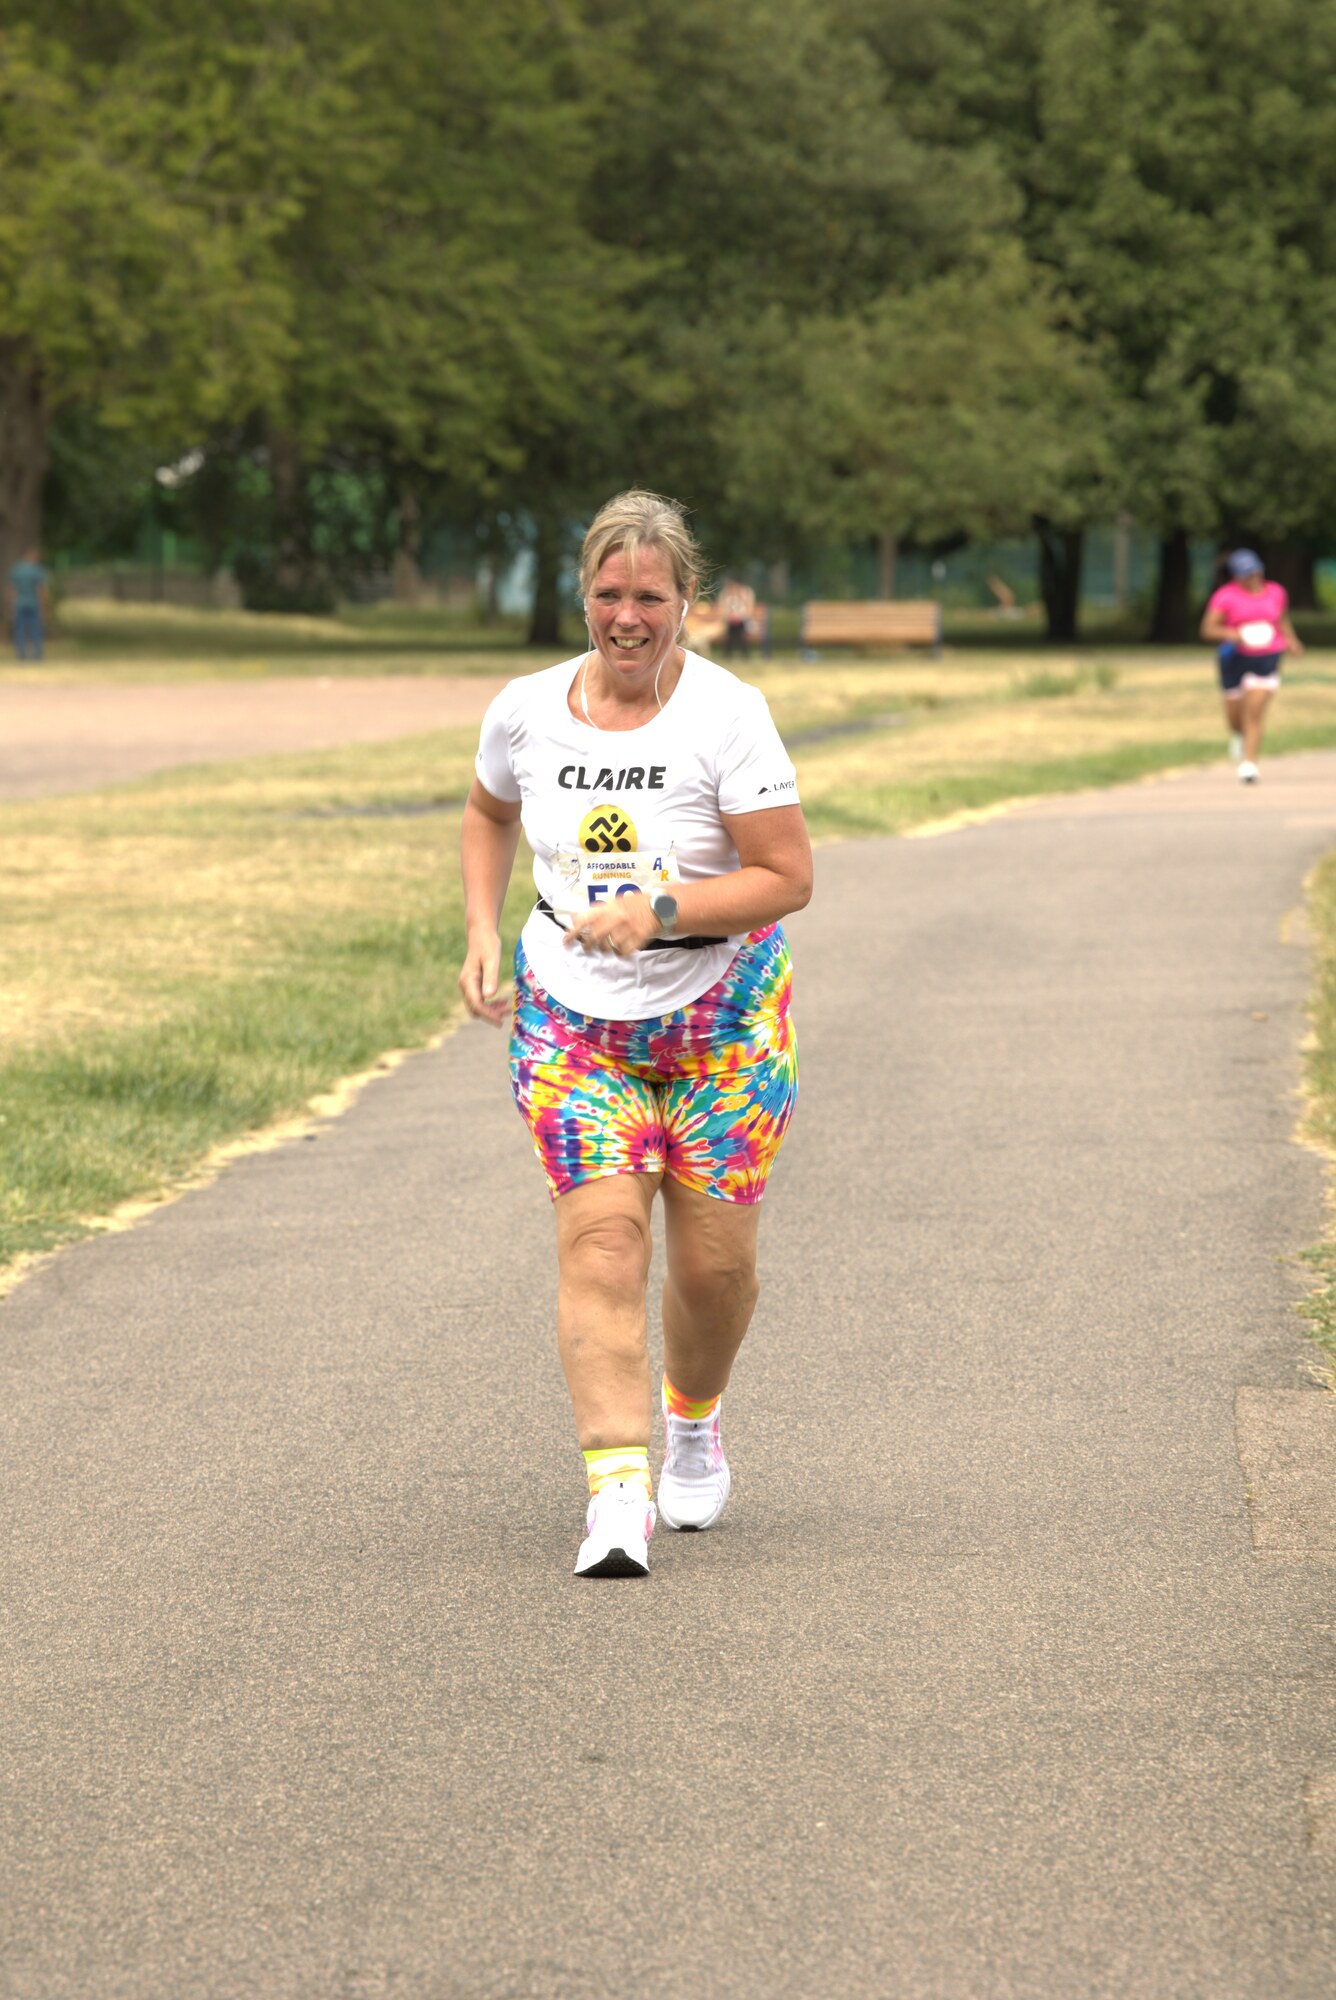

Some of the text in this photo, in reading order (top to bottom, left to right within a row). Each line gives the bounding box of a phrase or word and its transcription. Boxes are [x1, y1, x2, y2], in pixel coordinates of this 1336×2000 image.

[558, 765, 666, 791] CLAIRE
[586, 861, 636, 870] AFFORDABLE
[592, 871, 632, 880] RUNNING
